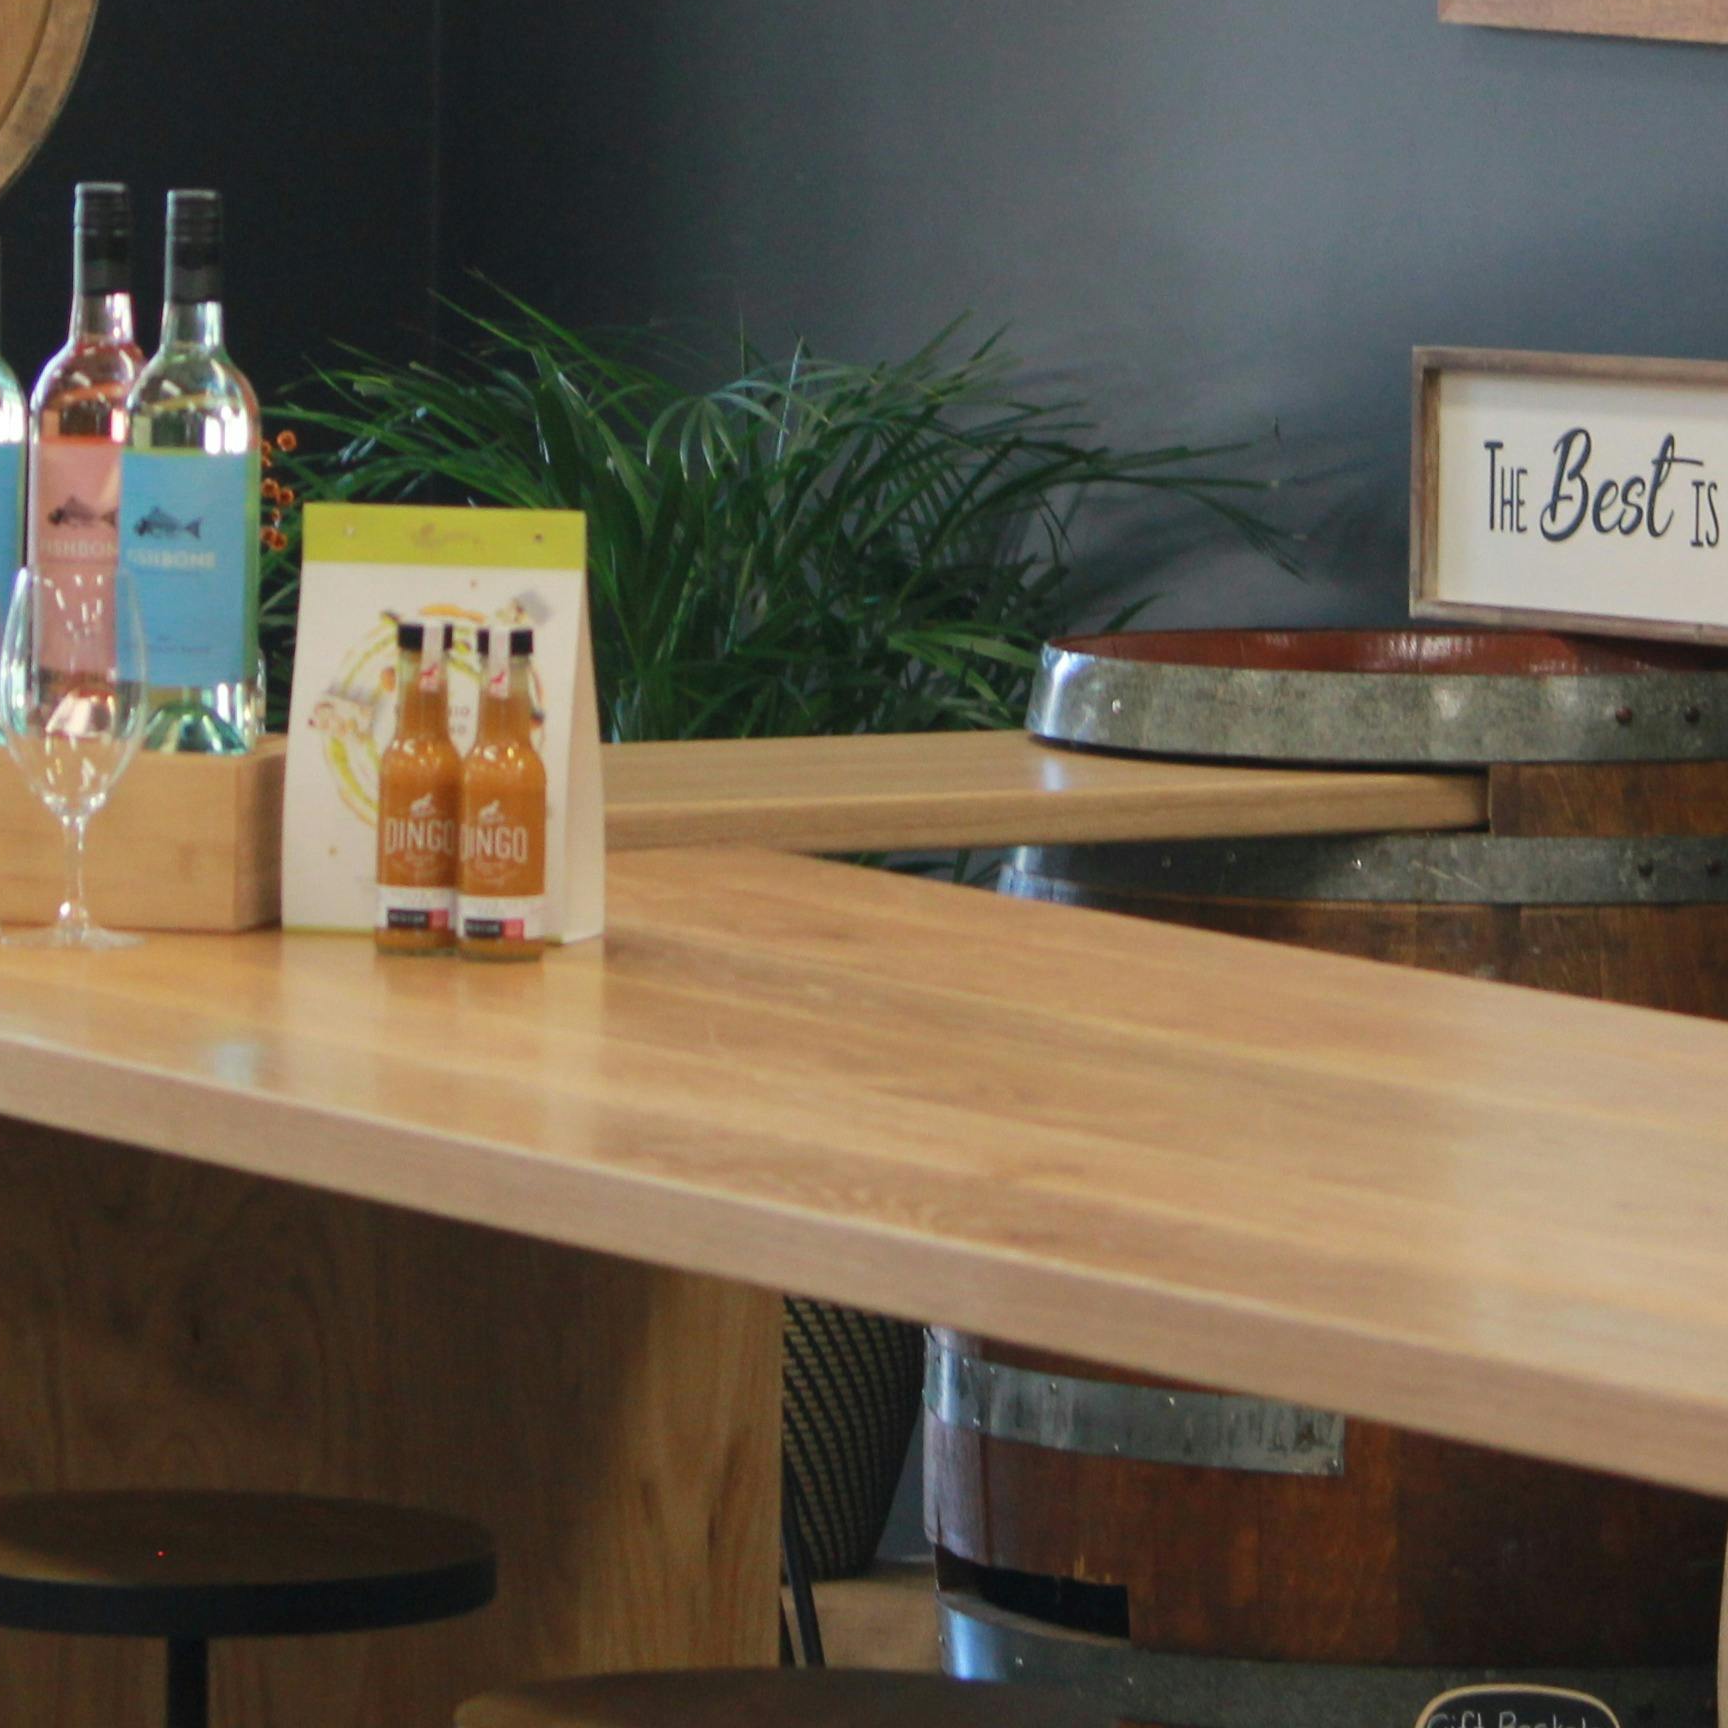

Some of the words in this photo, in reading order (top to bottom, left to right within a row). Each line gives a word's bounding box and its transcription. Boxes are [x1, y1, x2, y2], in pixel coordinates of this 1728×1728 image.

[1483, 440, 1528, 534] THE
[1539, 427, 1704, 543] Best
[1690, 479, 1720, 548] IS
[40, 538, 119, 559] FISHBON
[385, 817, 455, 856] DINGO
